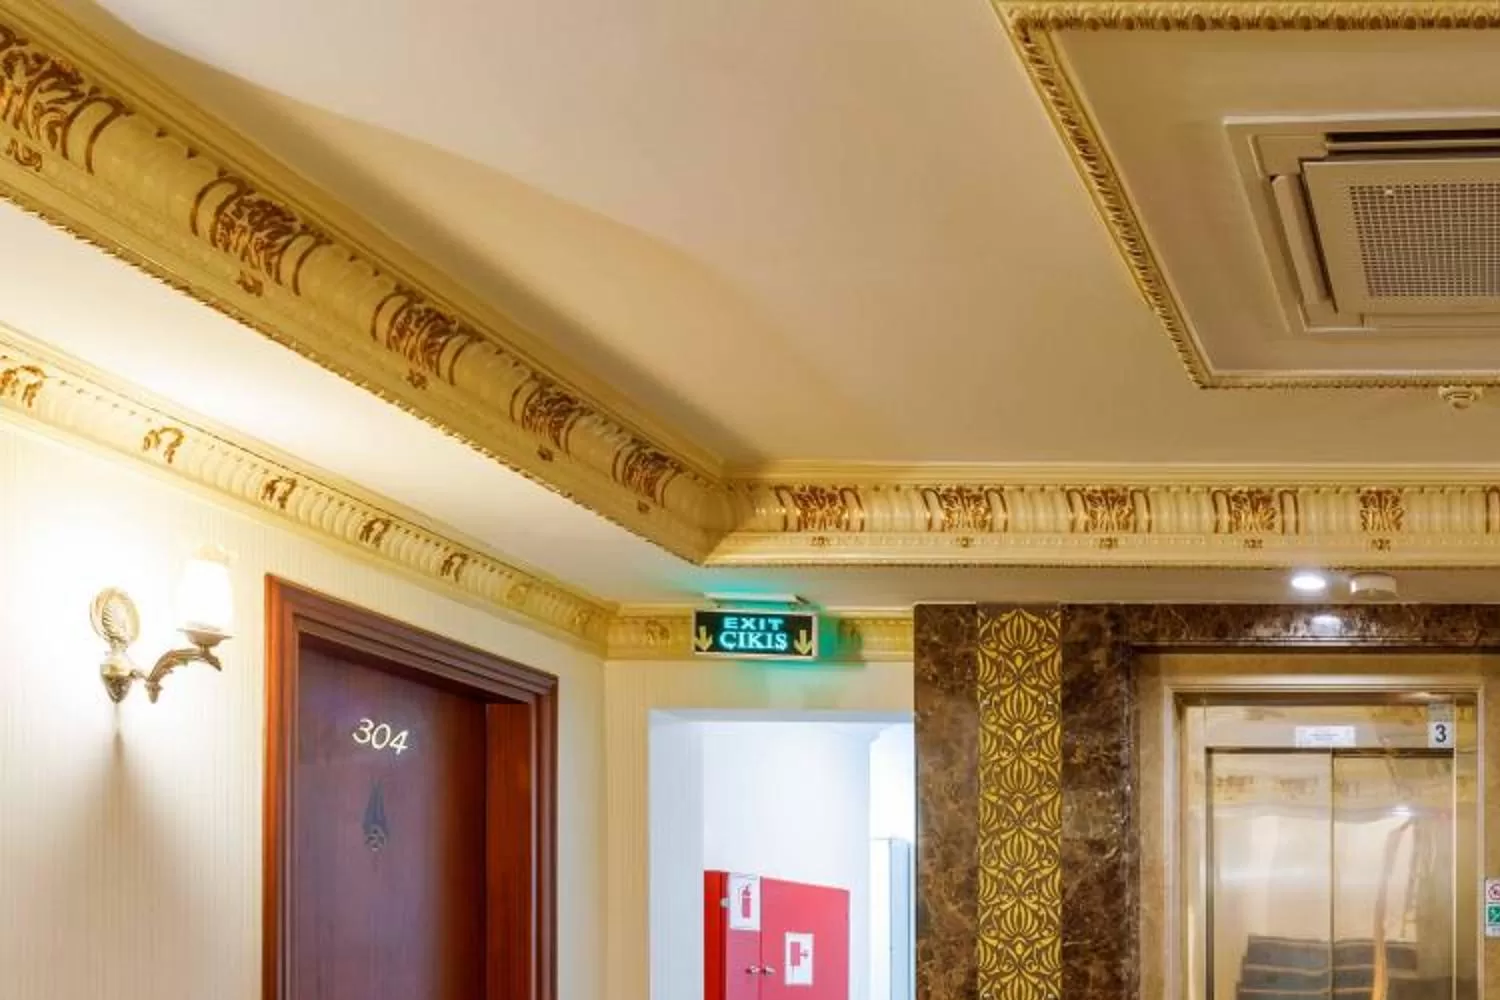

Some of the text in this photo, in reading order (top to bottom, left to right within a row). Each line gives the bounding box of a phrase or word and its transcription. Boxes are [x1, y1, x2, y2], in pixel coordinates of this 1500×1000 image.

[723, 616, 784, 631] EXIT
[352, 717, 409, 755] 304
[1435, 723, 1447, 743] 3
